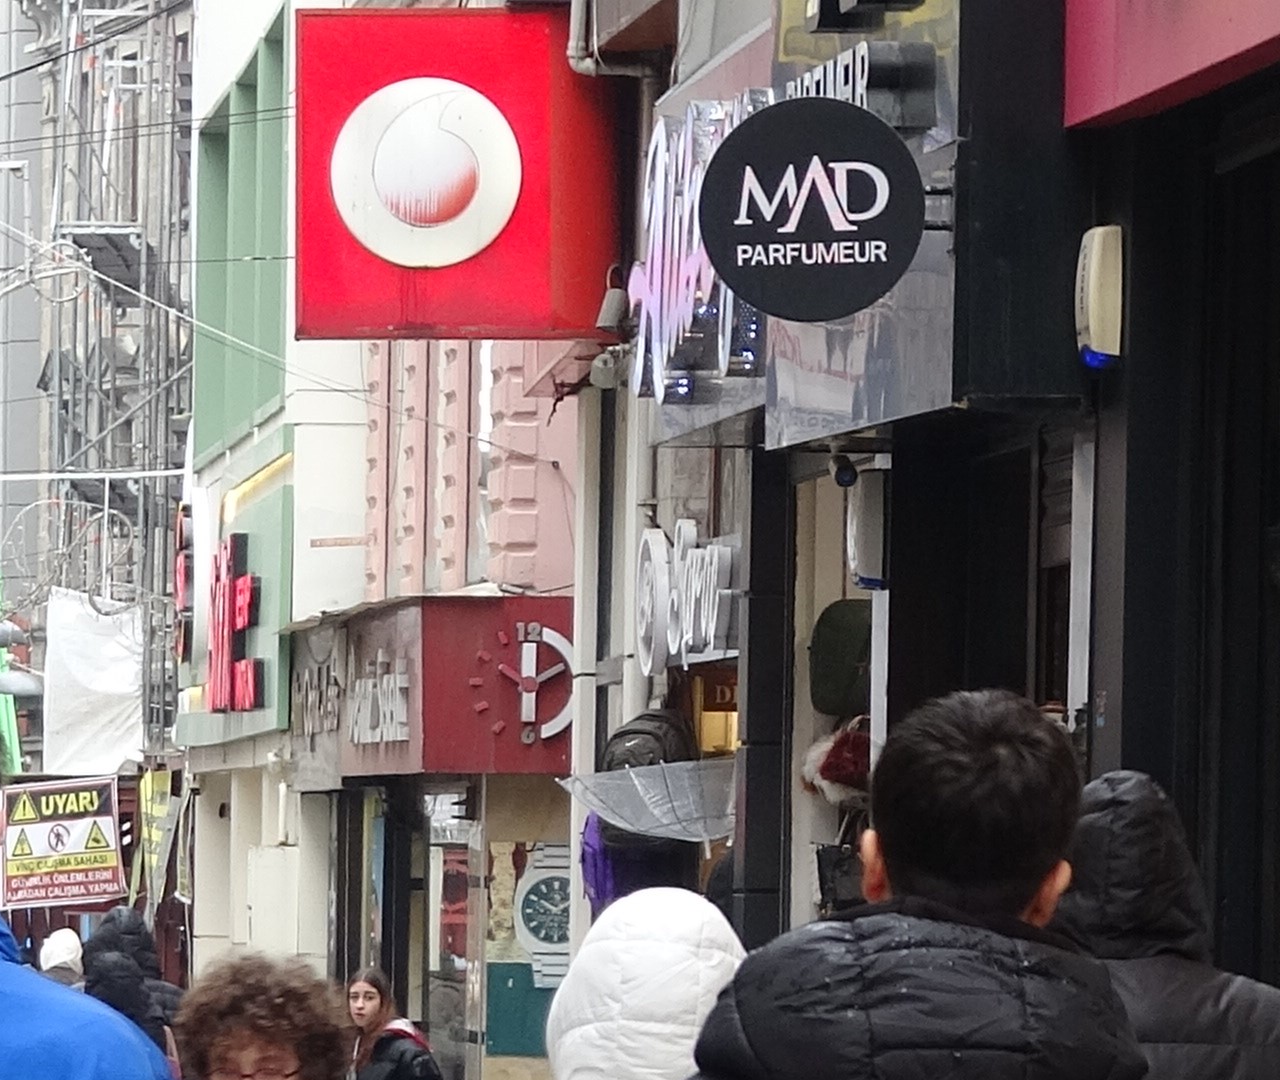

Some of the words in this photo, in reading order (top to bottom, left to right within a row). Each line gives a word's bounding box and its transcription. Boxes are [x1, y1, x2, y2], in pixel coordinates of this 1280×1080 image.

[733, 155, 890, 233] MAD
[736, 240, 888, 267] PARFUMEUR
[516, 621, 541, 642] 12
[521, 724, 536, 744] 6
